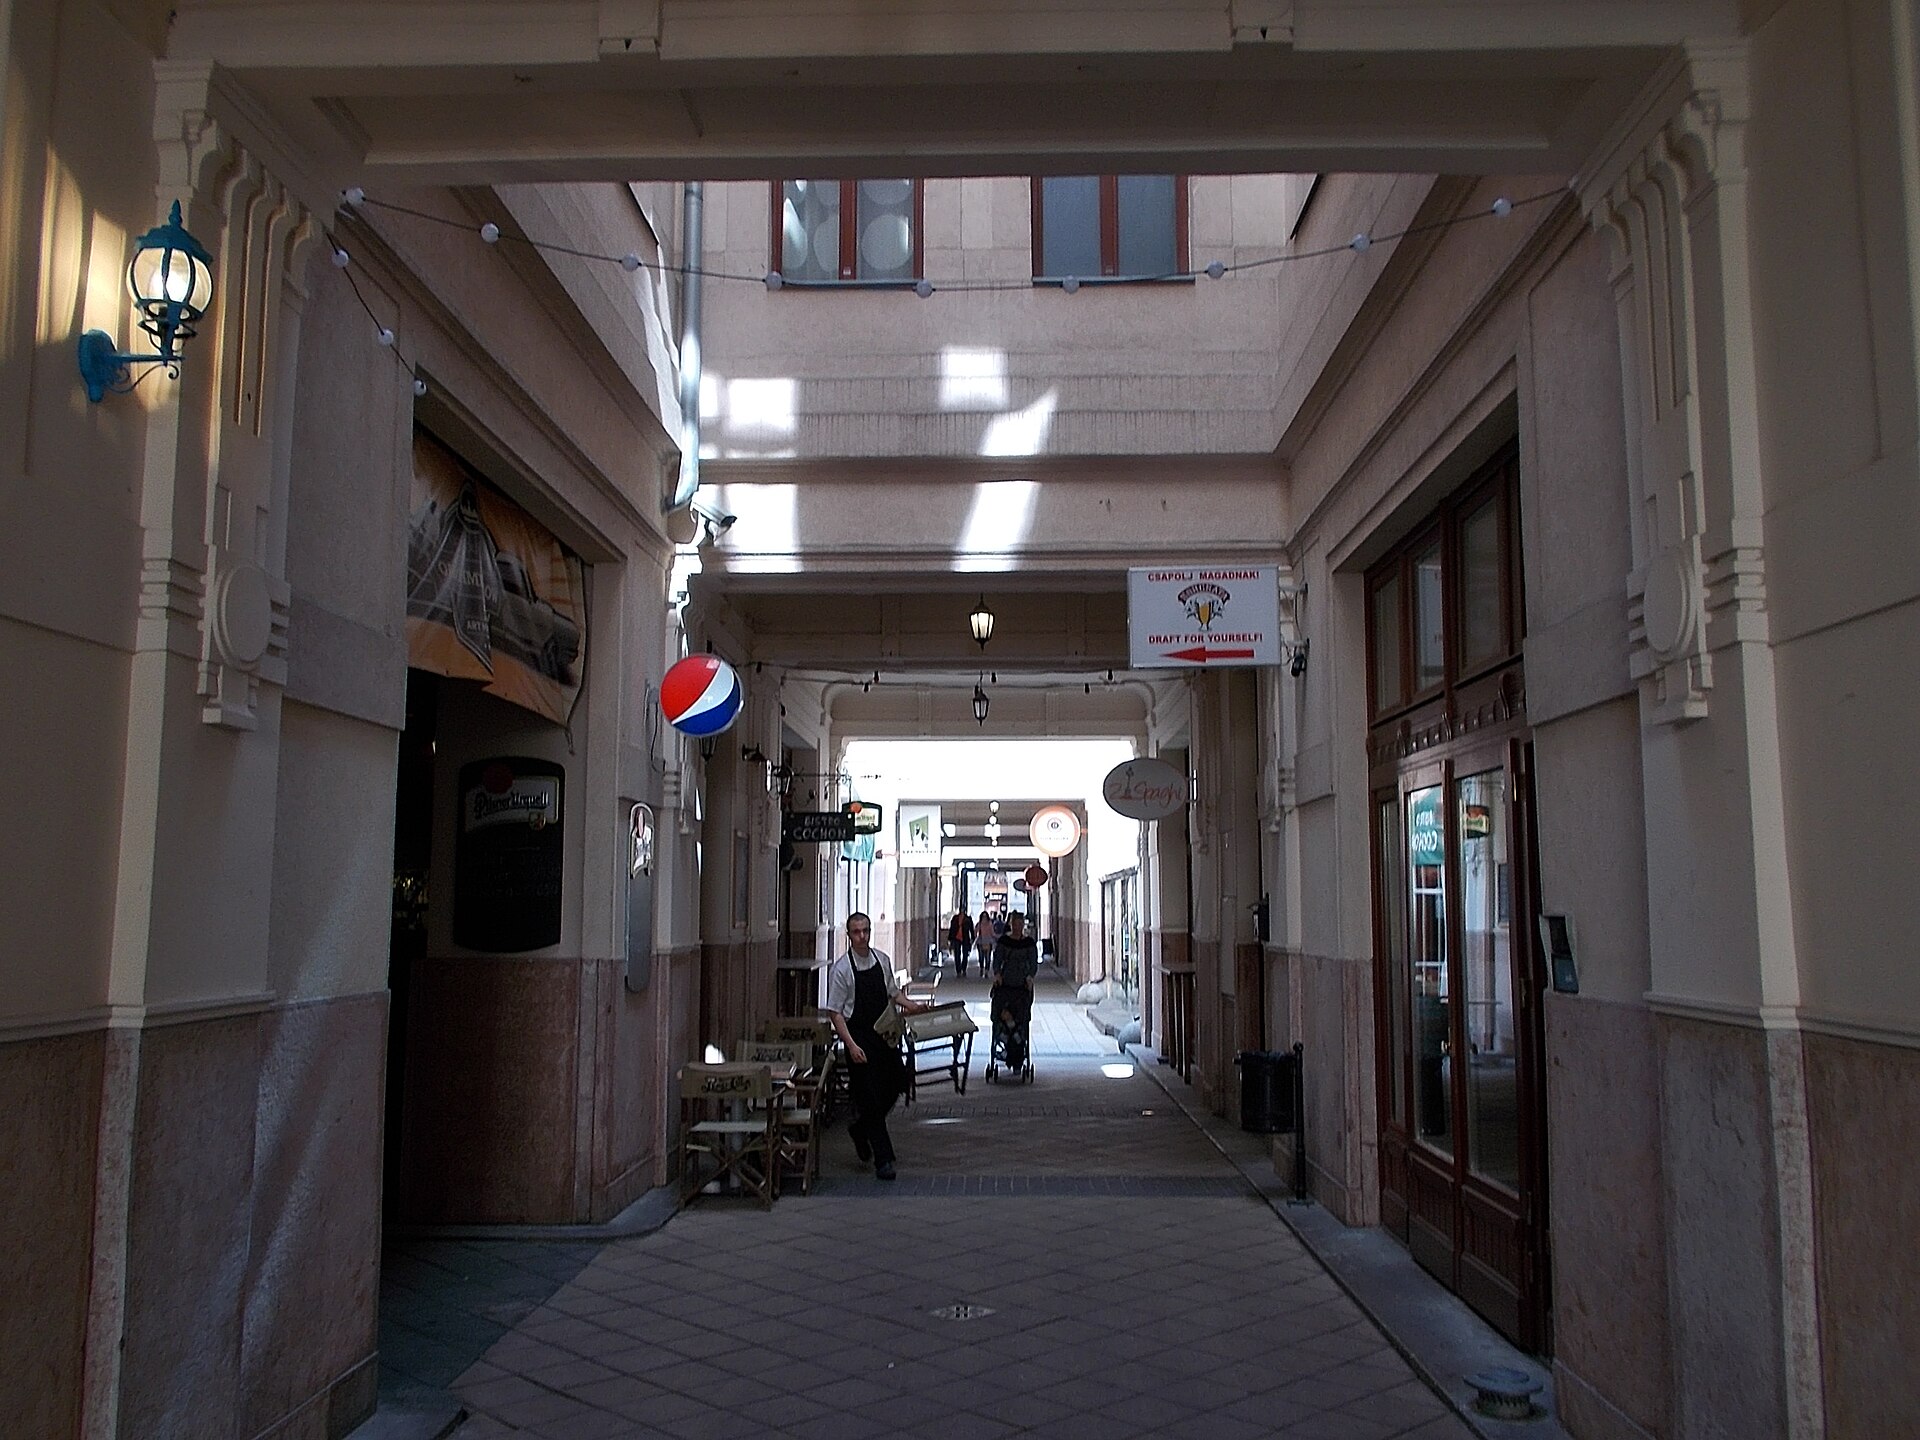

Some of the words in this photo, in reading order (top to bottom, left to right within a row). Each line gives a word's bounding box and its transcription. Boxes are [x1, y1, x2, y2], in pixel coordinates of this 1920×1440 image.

[1147, 571, 1194, 582] CSAPOLJ
[1148, 634, 1182, 645] DRAFT
[1184, 634, 1205, 643] FOR
[1207, 632, 1264, 643] YOURSELF!
[473, 791, 511, 820] Pilsner
[509, 790, 550, 811] Urquell
[804, 815, 840, 827] BISTRO
[792, 826, 847, 840] COCHON
